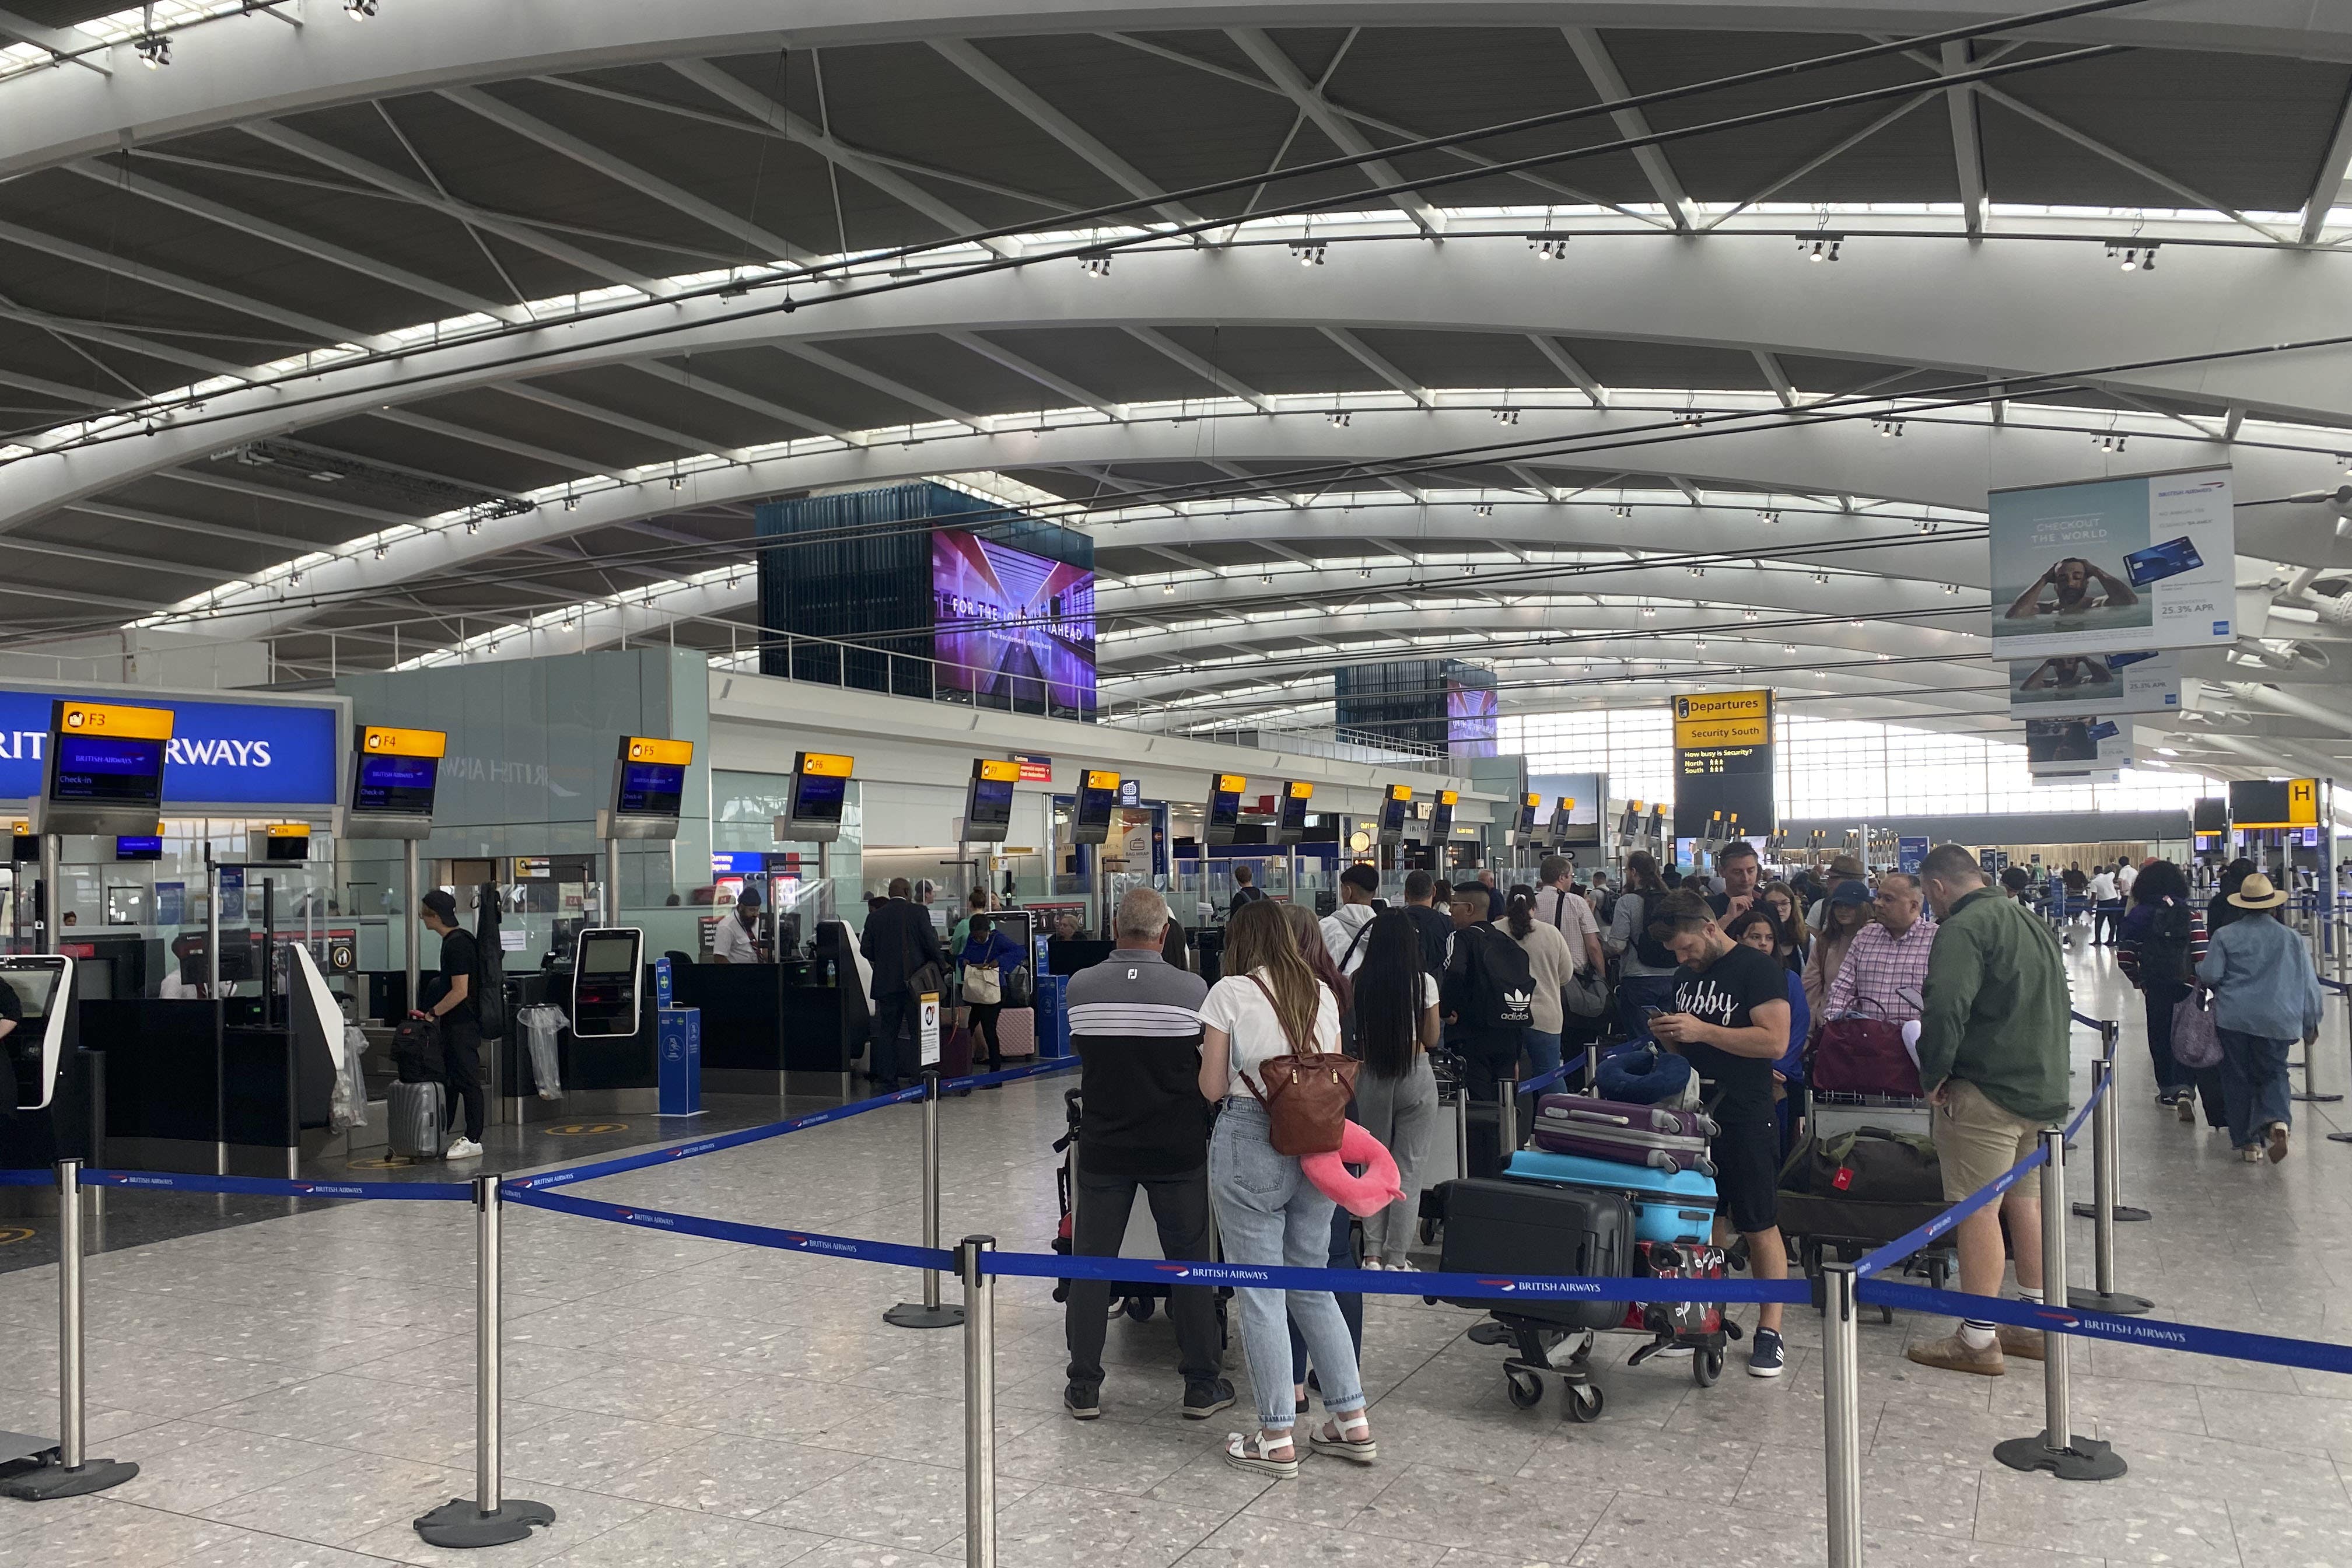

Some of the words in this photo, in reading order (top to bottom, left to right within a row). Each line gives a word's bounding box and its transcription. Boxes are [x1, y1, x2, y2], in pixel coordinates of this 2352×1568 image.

[2036, 518, 2100, 532] CHECKOUT
[2031, 534, 2056, 543] THE
[2061, 529, 2108, 540] WORLD
[2162, 606, 2192, 614] 25.3%
[953, 598, 974, 615] FOR
[978, 604, 998, 621] THE
[1051, 623, 1083, 640] AHEAD
[989, 630, 998, 639] The
[999, 632, 1026, 645] excitement
[1027, 639, 1041, 648] starts
[1690, 699, 1758, 713] Departures
[89, 713, 106, 726] F3
[1692, 729, 1729, 738] Security
[1732, 727, 1759, 736] South
[383, 736, 396, 747] F4
[165, 737, 272, 768] RWAYS
[644, 746, 654, 755] F5
[1723, 748, 1752, 757] Security?
[815, 760, 823, 769] F6
[991, 766, 998, 775] F7
[60, 775, 92, 784] Check-in
[360, 788, 384, 796] Check-in
[2294, 785, 2310, 801] H
[1675, 980, 1740, 1026] Hubby
[1500, 1012, 1529, 1020] adidas
[803, 1116, 816, 1125] BRITISH
[816, 1114, 828, 1122] AIRWAYS
[683, 1146, 699, 1154] BRITISH
[699, 1143, 715, 1152] AIRWAYS
[129, 1176, 150, 1185] BRITISH
[150, 1177, 173, 1185] AIRWAYS
[534, 1176, 554, 1186] BRITISH
[553, 1172, 574, 1182] AIRWAYS
[338, 1186, 363, 1195] AIRWAYS
[634, 1213, 653, 1223] BRITISH
[653, 1215, 674, 1226] AIRWAYS
[809, 1240, 832, 1250] BRITISH
[832, 1242, 857, 1252] AIRWAYS
[1192, 1268, 1228, 1278] BRITISH
[1230, 1270, 1268, 1280] AIRWAYS
[1519, 1282, 1558, 1291] BRITISH
[1559, 1283, 1601, 1293] AIRWAYS
[2084, 1319, 2132, 1335] BRITISH
[2133, 1326, 2186, 1342] AIRWAYS
